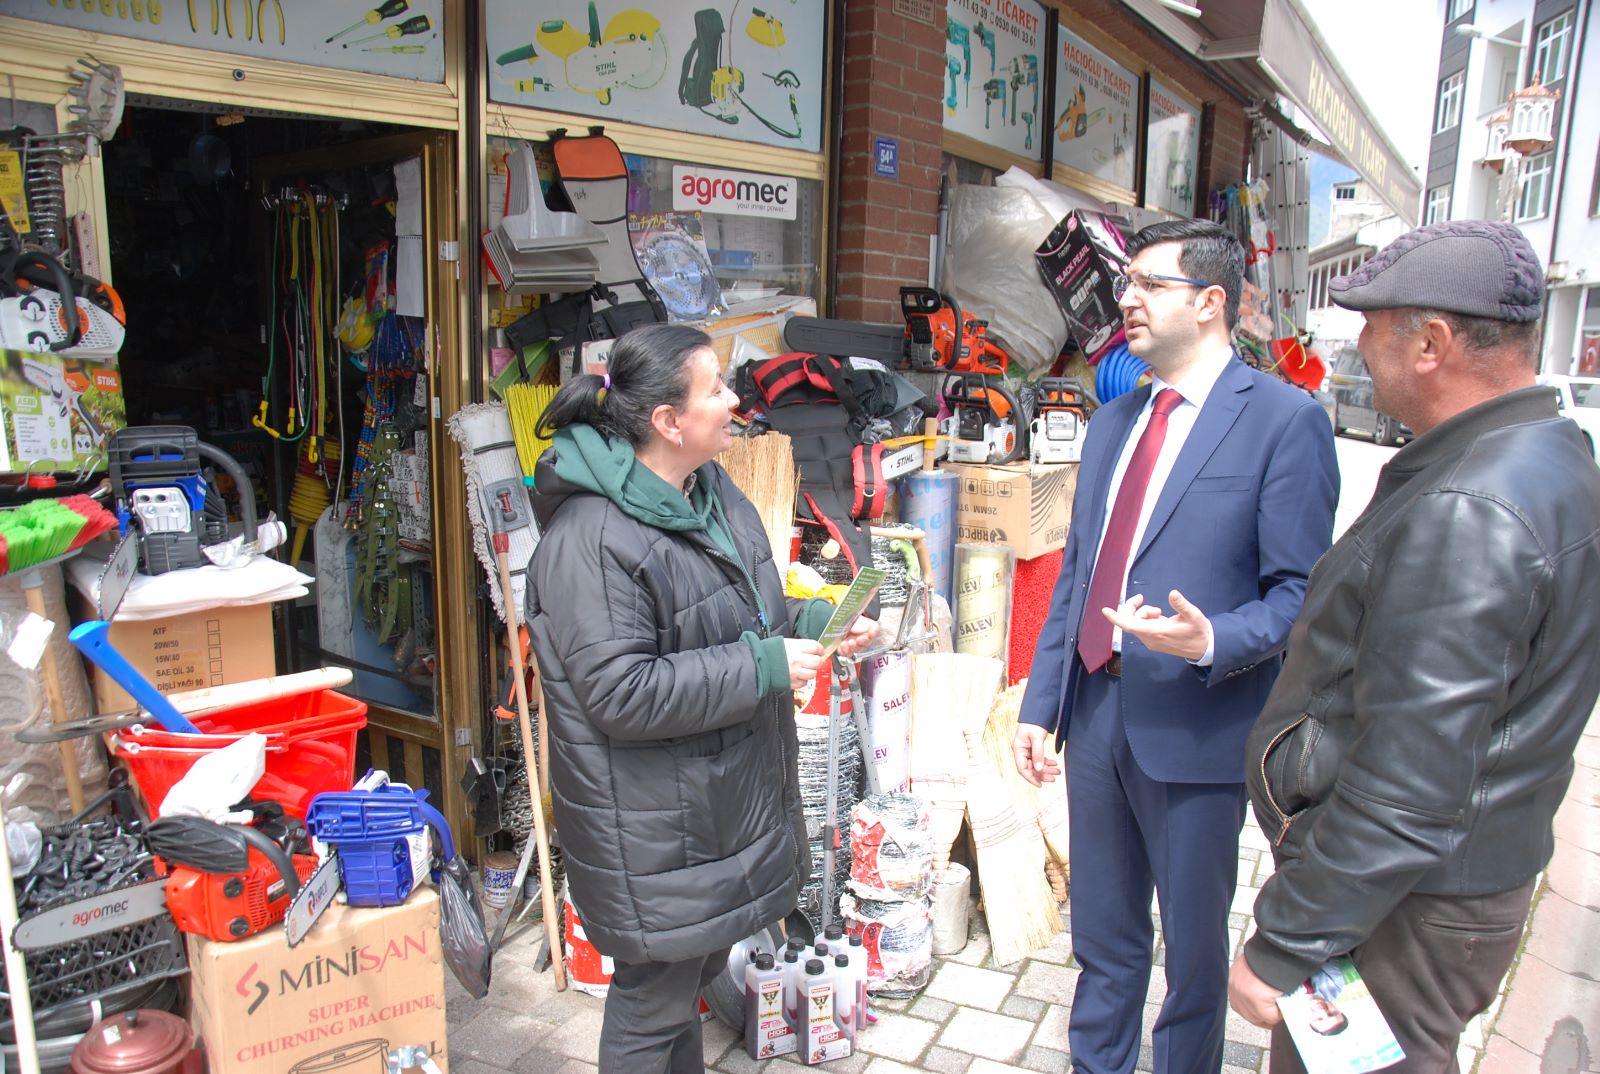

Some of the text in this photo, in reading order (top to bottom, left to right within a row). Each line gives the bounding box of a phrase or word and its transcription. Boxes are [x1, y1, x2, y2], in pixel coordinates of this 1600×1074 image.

[971, 1, 978, 15] 43
[980, 6, 988, 20] 39
[995, 15, 1009, 33] 0530
[595, 61, 616, 72] STIHL
[681, 175, 788, 206] agromec
[737, 202, 750, 210] your
[751, 203, 766, 211] inner
[1055, 264, 1075, 286] BLACK
[1071, 244, 1091, 267] PEARL
[97, 375, 118, 387] STIHL
[896, 453, 915, 469] STIHL
[958, 529, 989, 542] RAPCO
[152, 626, 167, 636] ATF
[960, 617, 993, 636] SALEV
[156, 668, 172, 678] SAE
[72, 900, 129, 927] agromec
[279, 930, 427, 996] MİNİSAN
[308, 994, 370, 1024] SUPER
[236, 993, 436, 1063] CHURNING MACHINE
[768, 1028, 788, 1039] HIGH
[820, 1032, 839, 1044] HIGH
